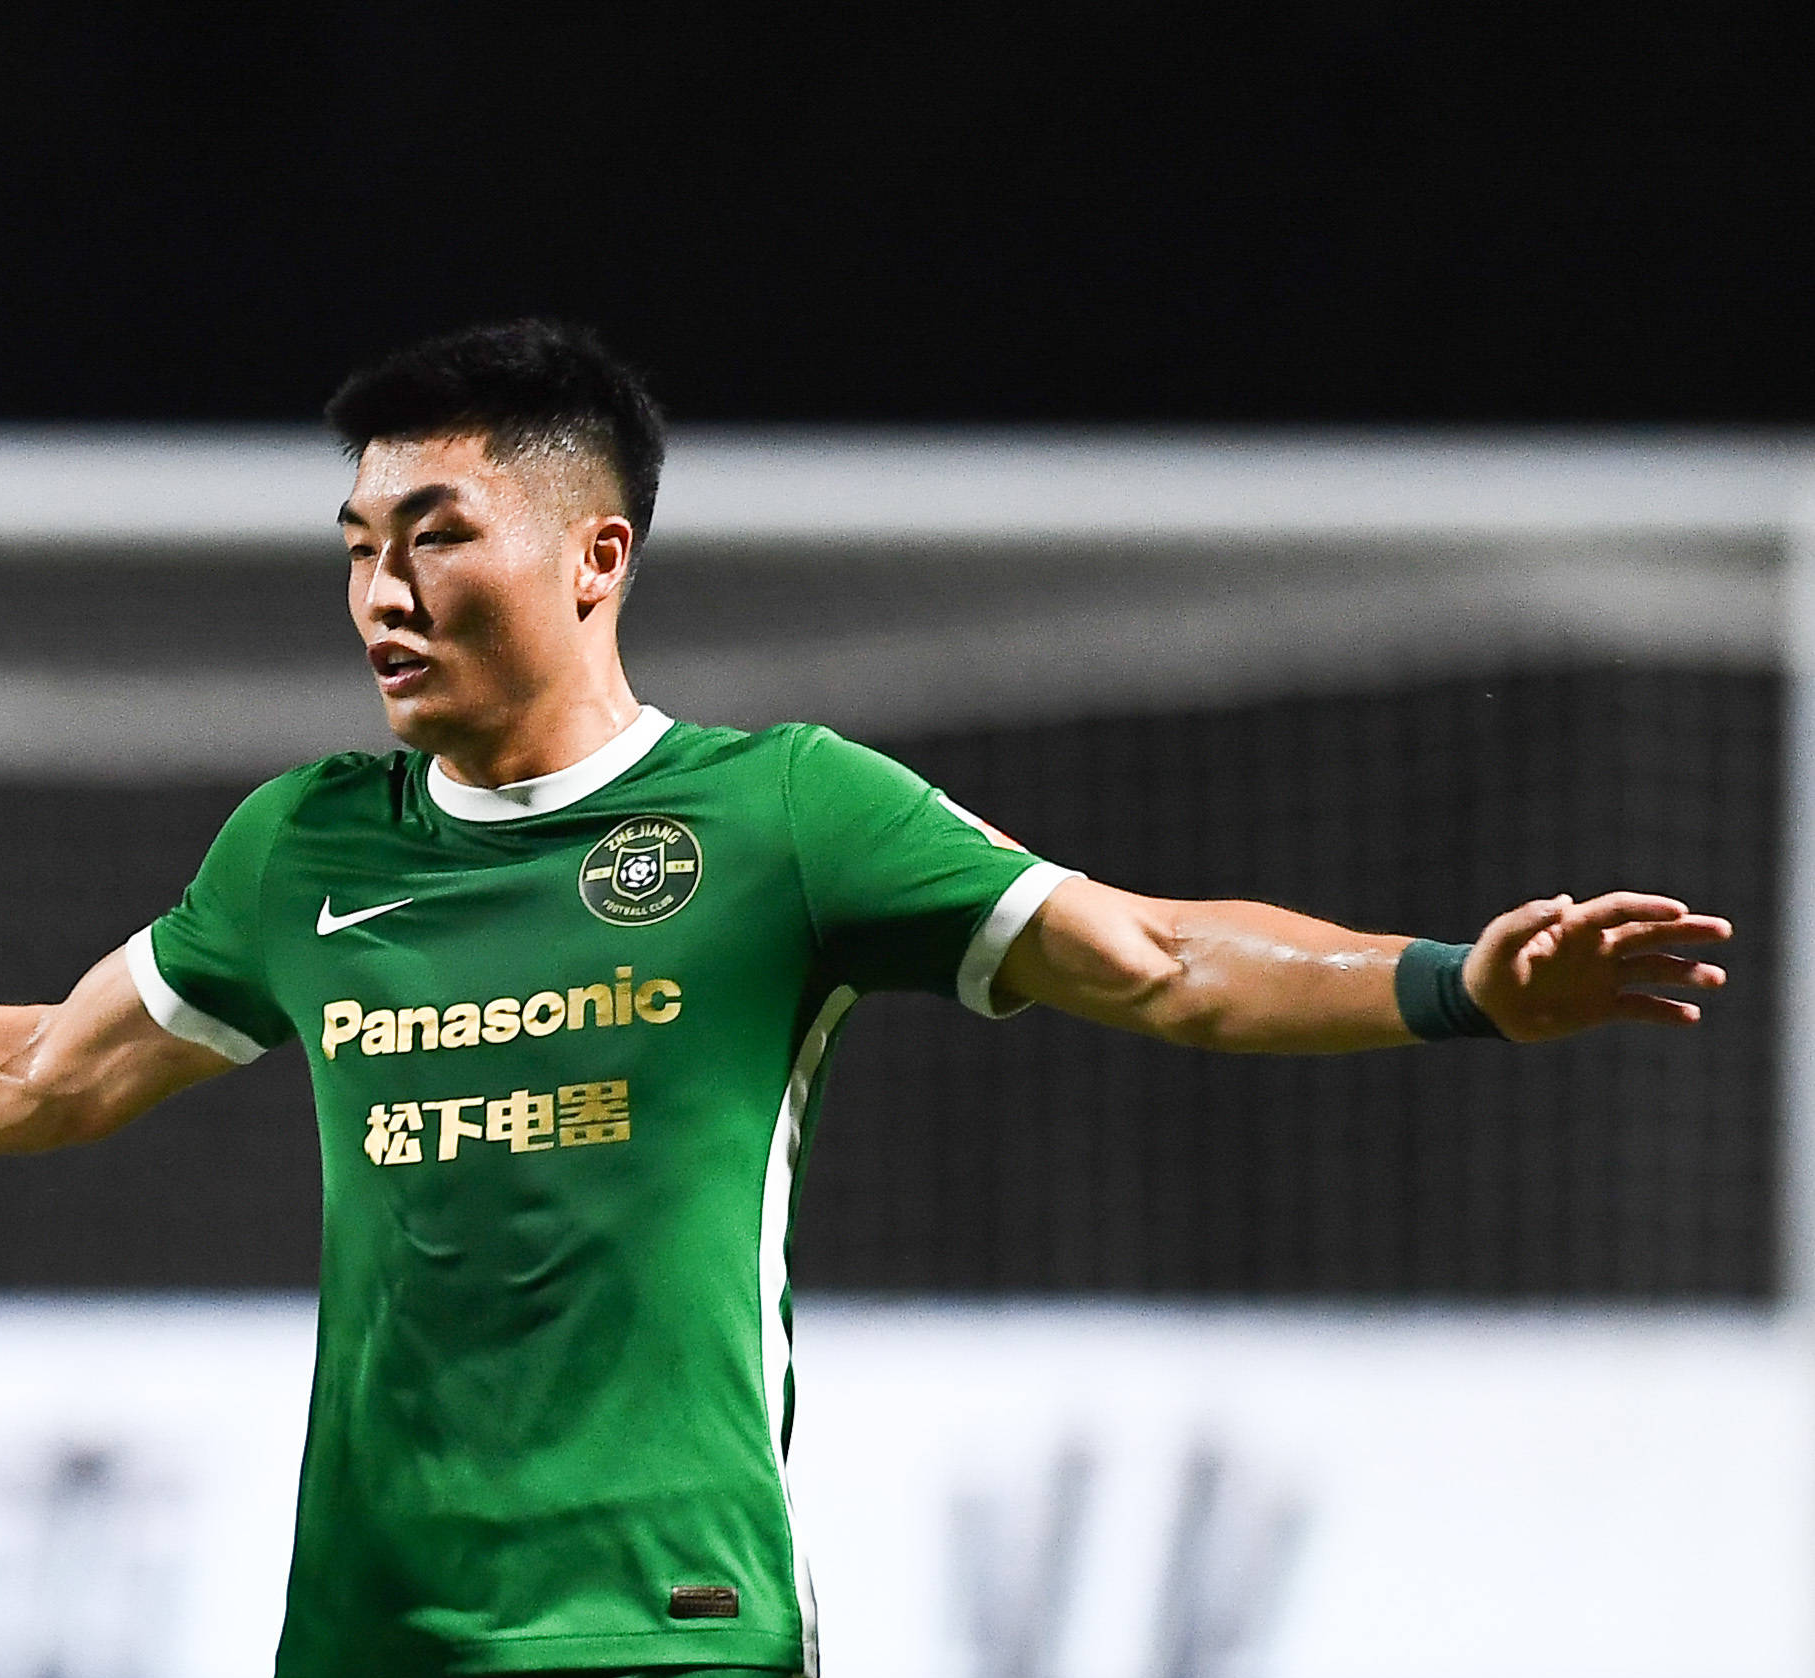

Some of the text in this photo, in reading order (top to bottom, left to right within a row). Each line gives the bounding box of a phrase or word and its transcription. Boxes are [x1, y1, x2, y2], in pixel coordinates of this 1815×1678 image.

[604, 824, 682, 852] ZHEJIANG
[602, 899, 648, 916] FOOTBALL
[322, 966, 682, 1060] Panasonic
[364, 1079, 632, 1167] 松下电器
